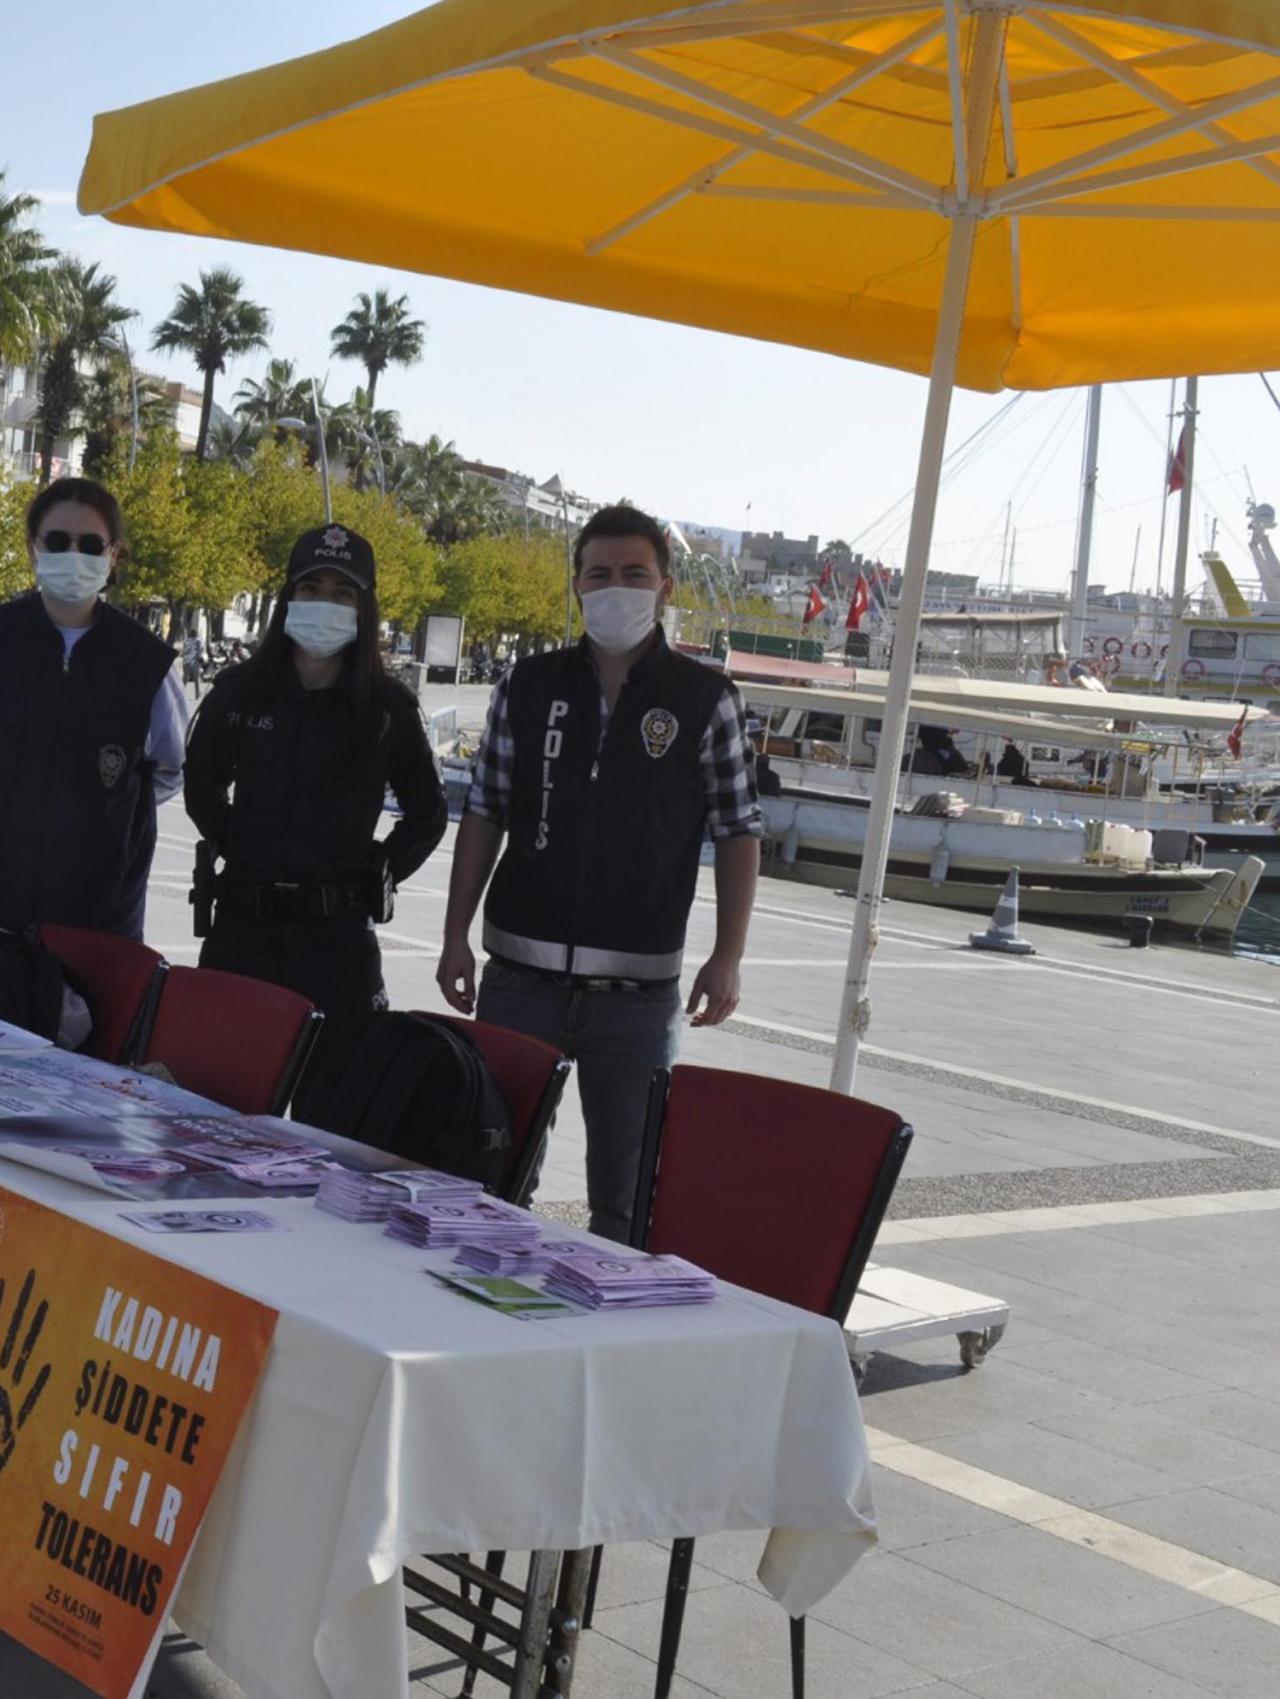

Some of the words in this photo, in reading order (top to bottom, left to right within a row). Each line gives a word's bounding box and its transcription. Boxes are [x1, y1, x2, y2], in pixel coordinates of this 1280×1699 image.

[94, 1286, 221, 1393] KADINA
[74, 1359, 205, 1466] ŞİDDETE
[53, 1429, 183, 1546] SIFIR
[34, 1501, 163, 1617] TOLERANS
[45, 1583, 60, 1604] 25
[62, 1593, 102, 1630] KASIM
